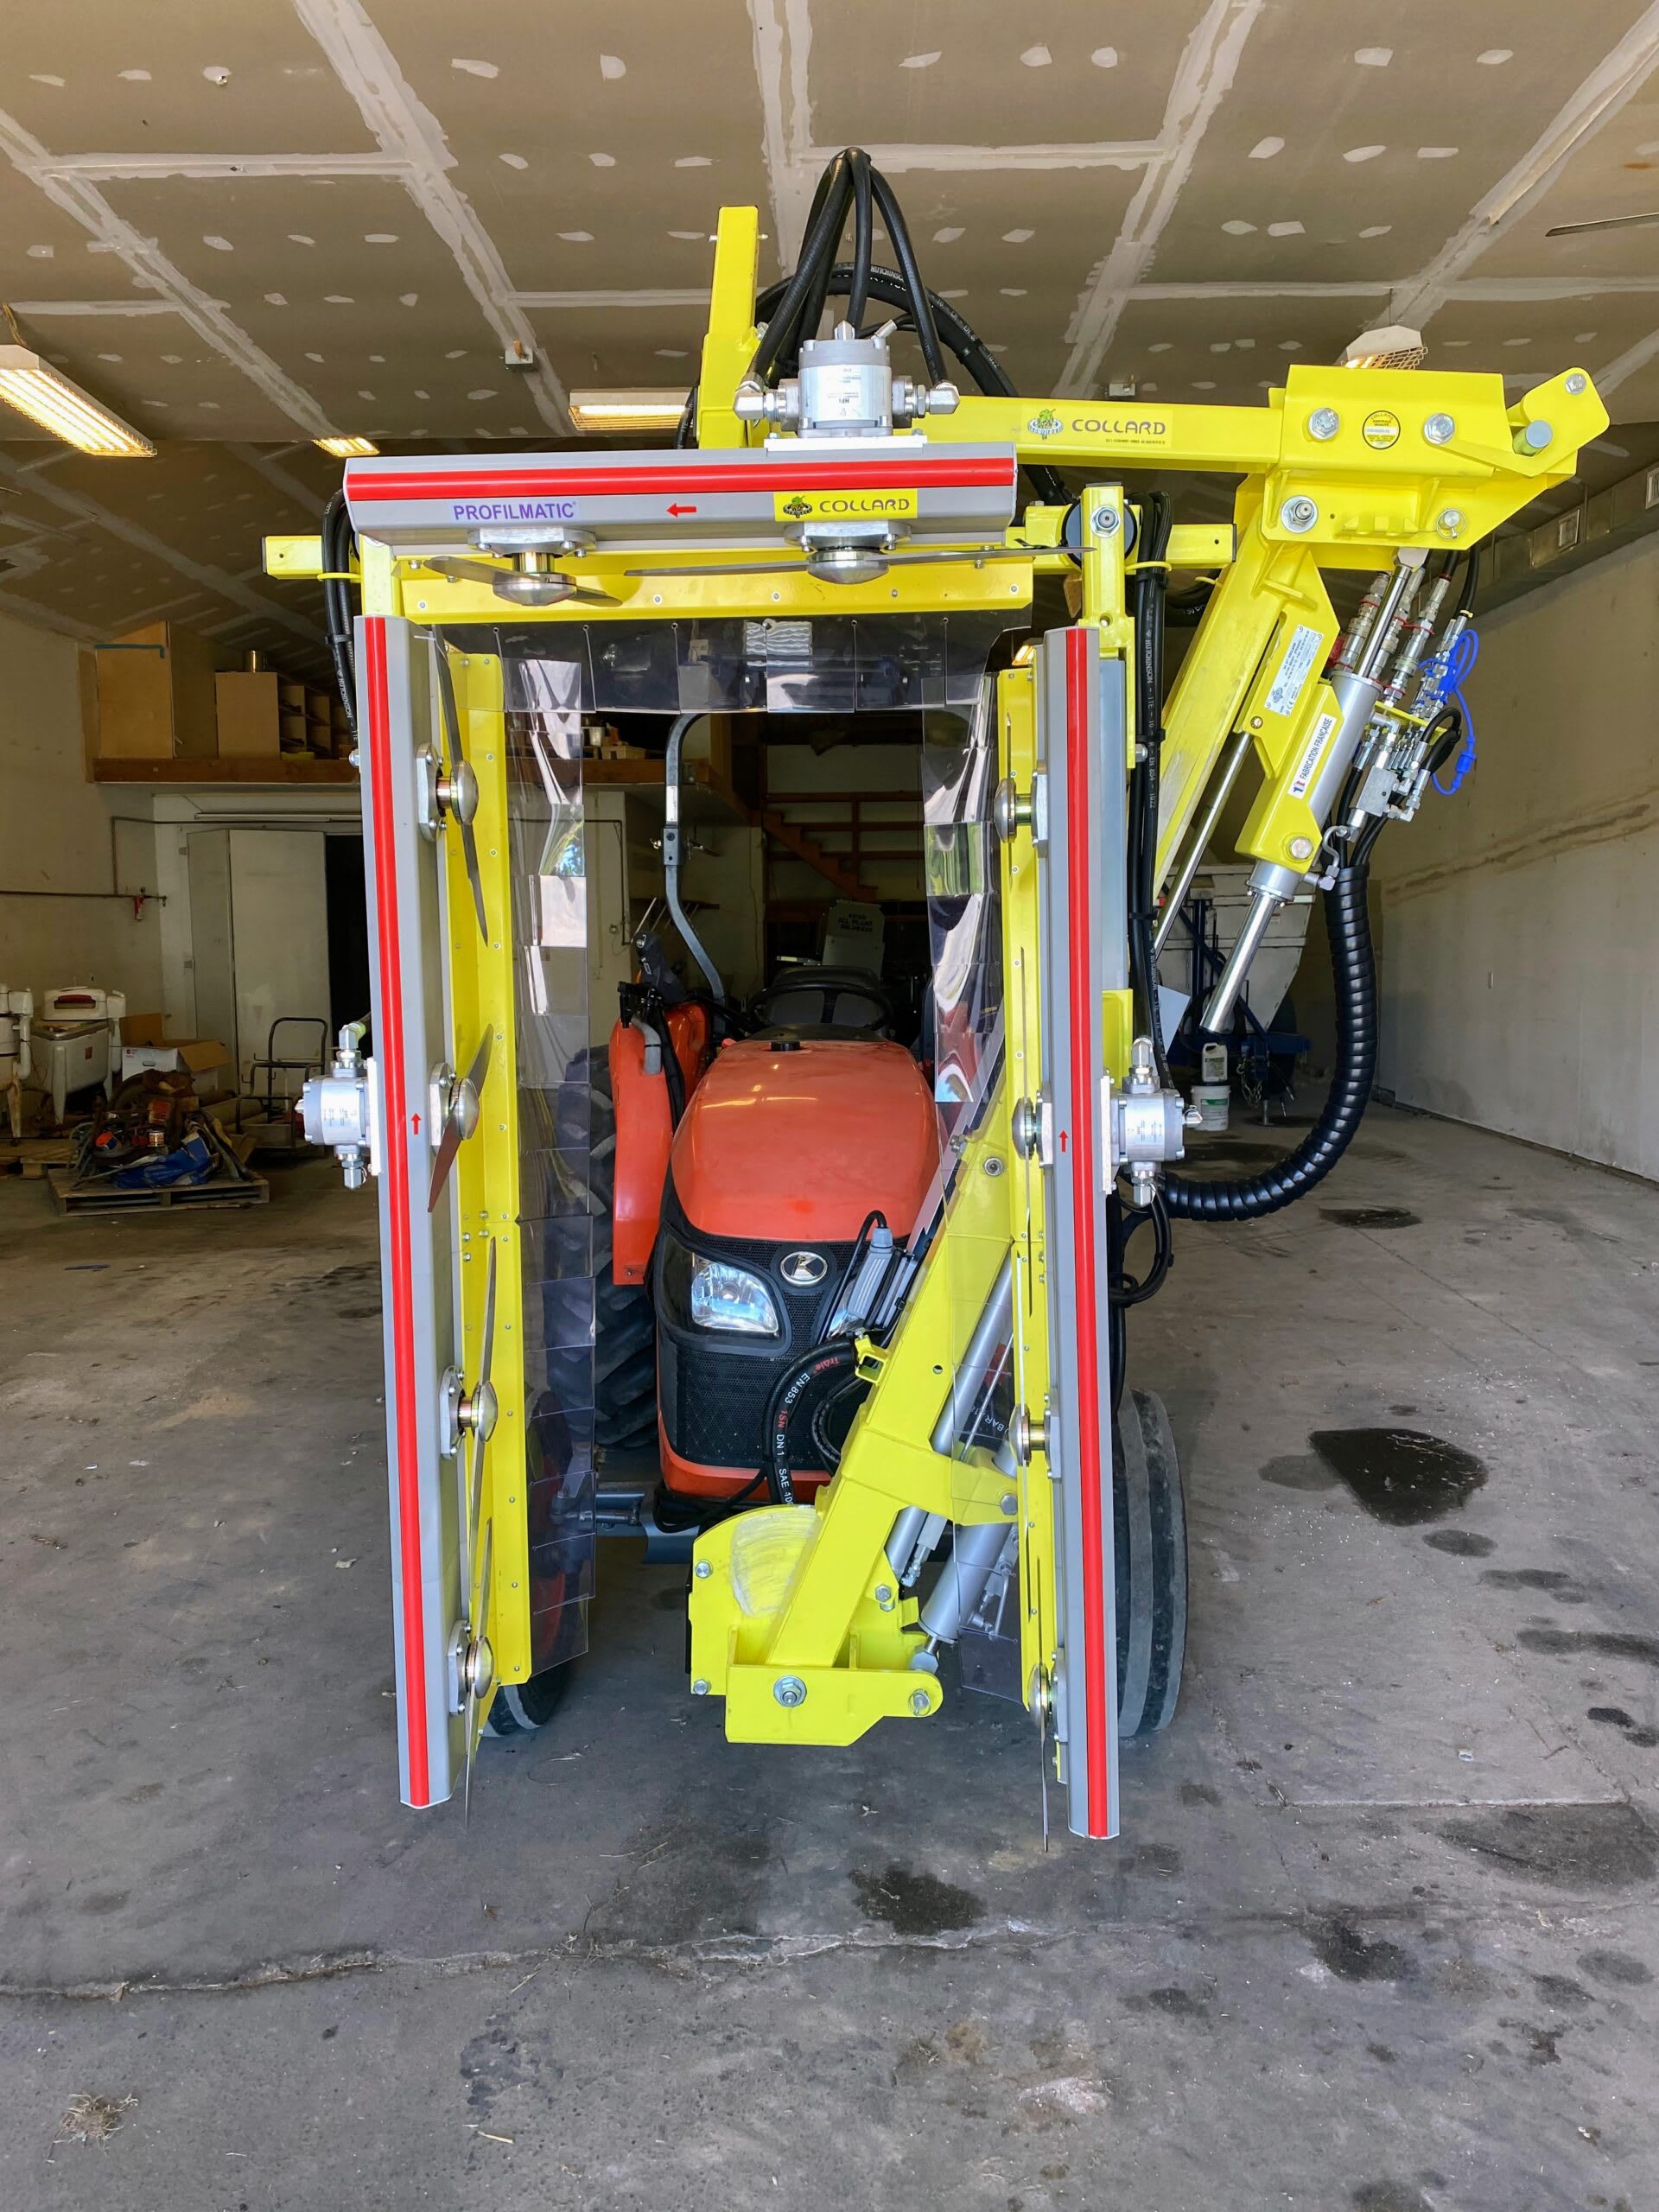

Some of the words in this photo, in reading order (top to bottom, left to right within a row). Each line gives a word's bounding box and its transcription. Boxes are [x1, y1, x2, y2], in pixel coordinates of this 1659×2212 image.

[1072, 419, 1166, 435] COLLARD
[453, 502, 574, 520] PROFILMATIC
[819, 498, 910, 512] COLLARD
[339, 677, 353, 718] HUTCHINSON
[1300, 747, 1319, 779] FABRICATION
[1313, 717, 1332, 747] FRANÇAISE
[1149, 757, 1154, 766] EN
[796, 1372, 810, 1388] EN
[785, 1386, 798, 1403] 853
[778, 1410, 788, 1427] 1SN
[985, 1415, 1004, 1431] BAR
[776, 1434, 785, 1448] DN
[779, 1469, 790, 1488] SAE
